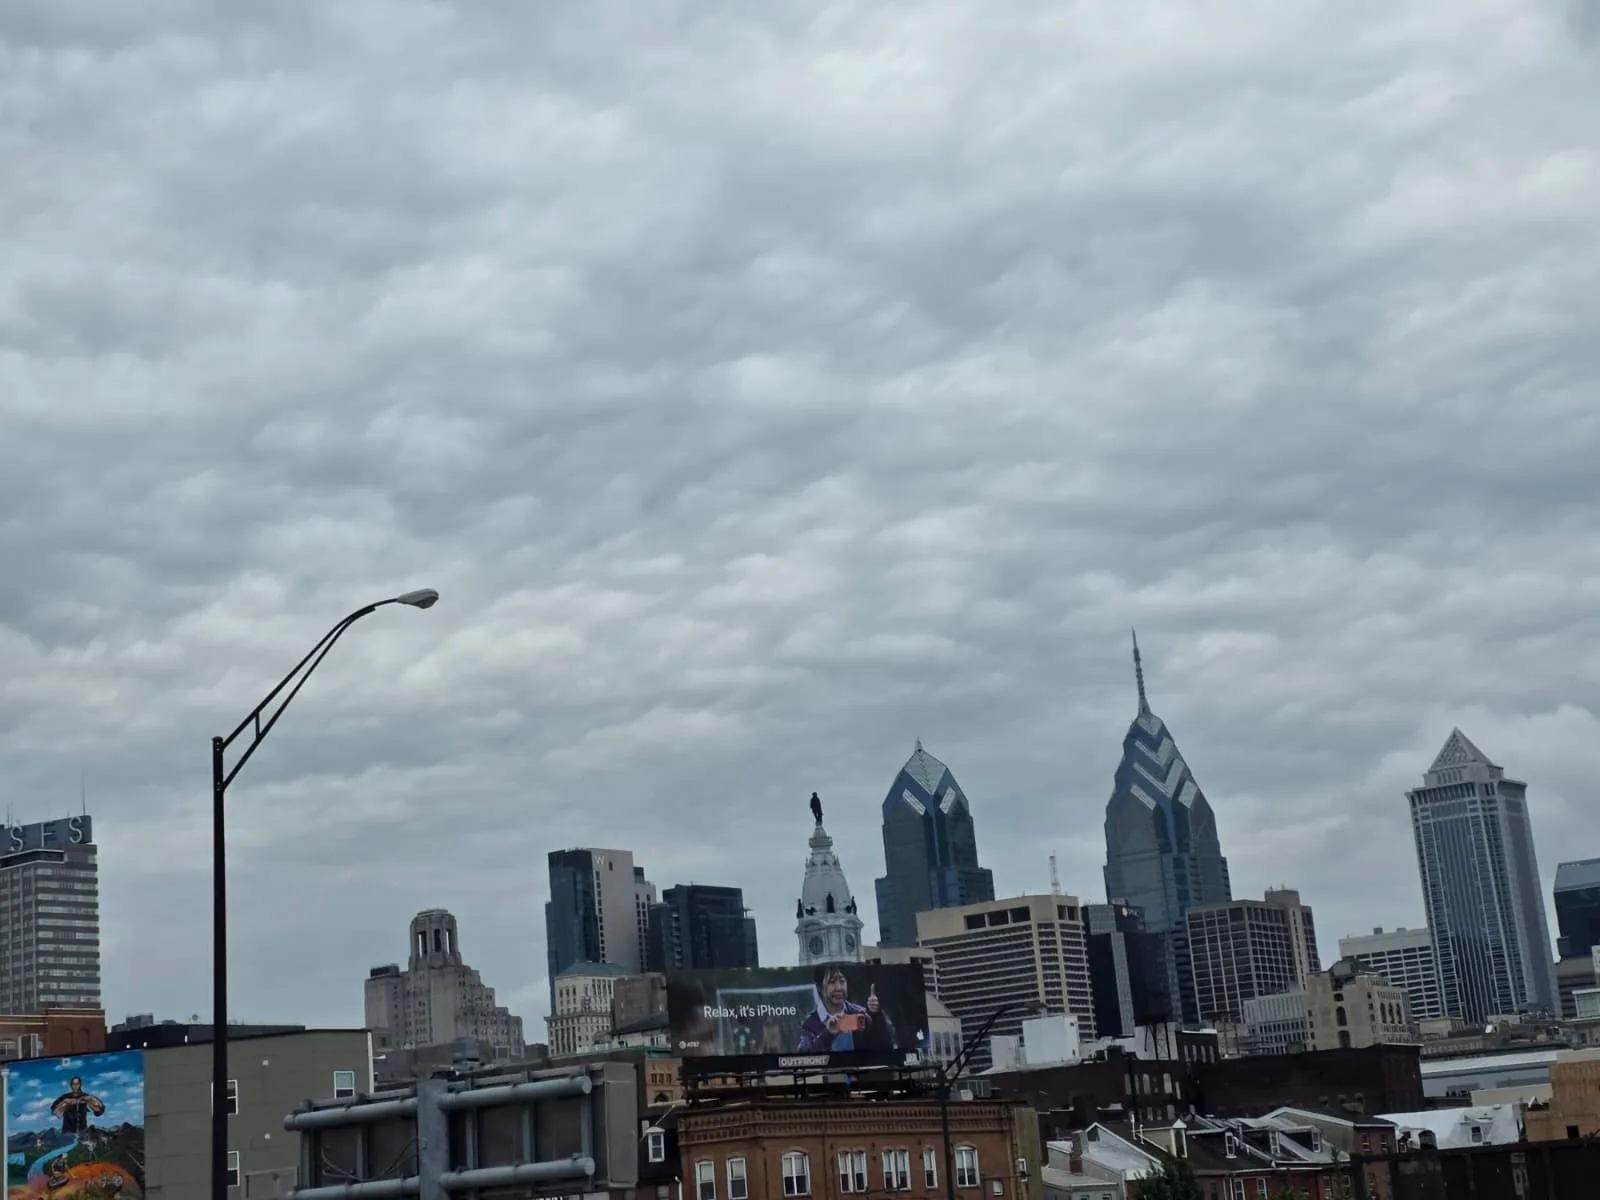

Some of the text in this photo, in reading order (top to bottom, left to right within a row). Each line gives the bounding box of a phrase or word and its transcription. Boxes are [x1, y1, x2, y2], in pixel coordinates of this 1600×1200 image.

[594, 855, 605, 865] W
[703, 1004, 797, 1019] Relax, it's iPhone
